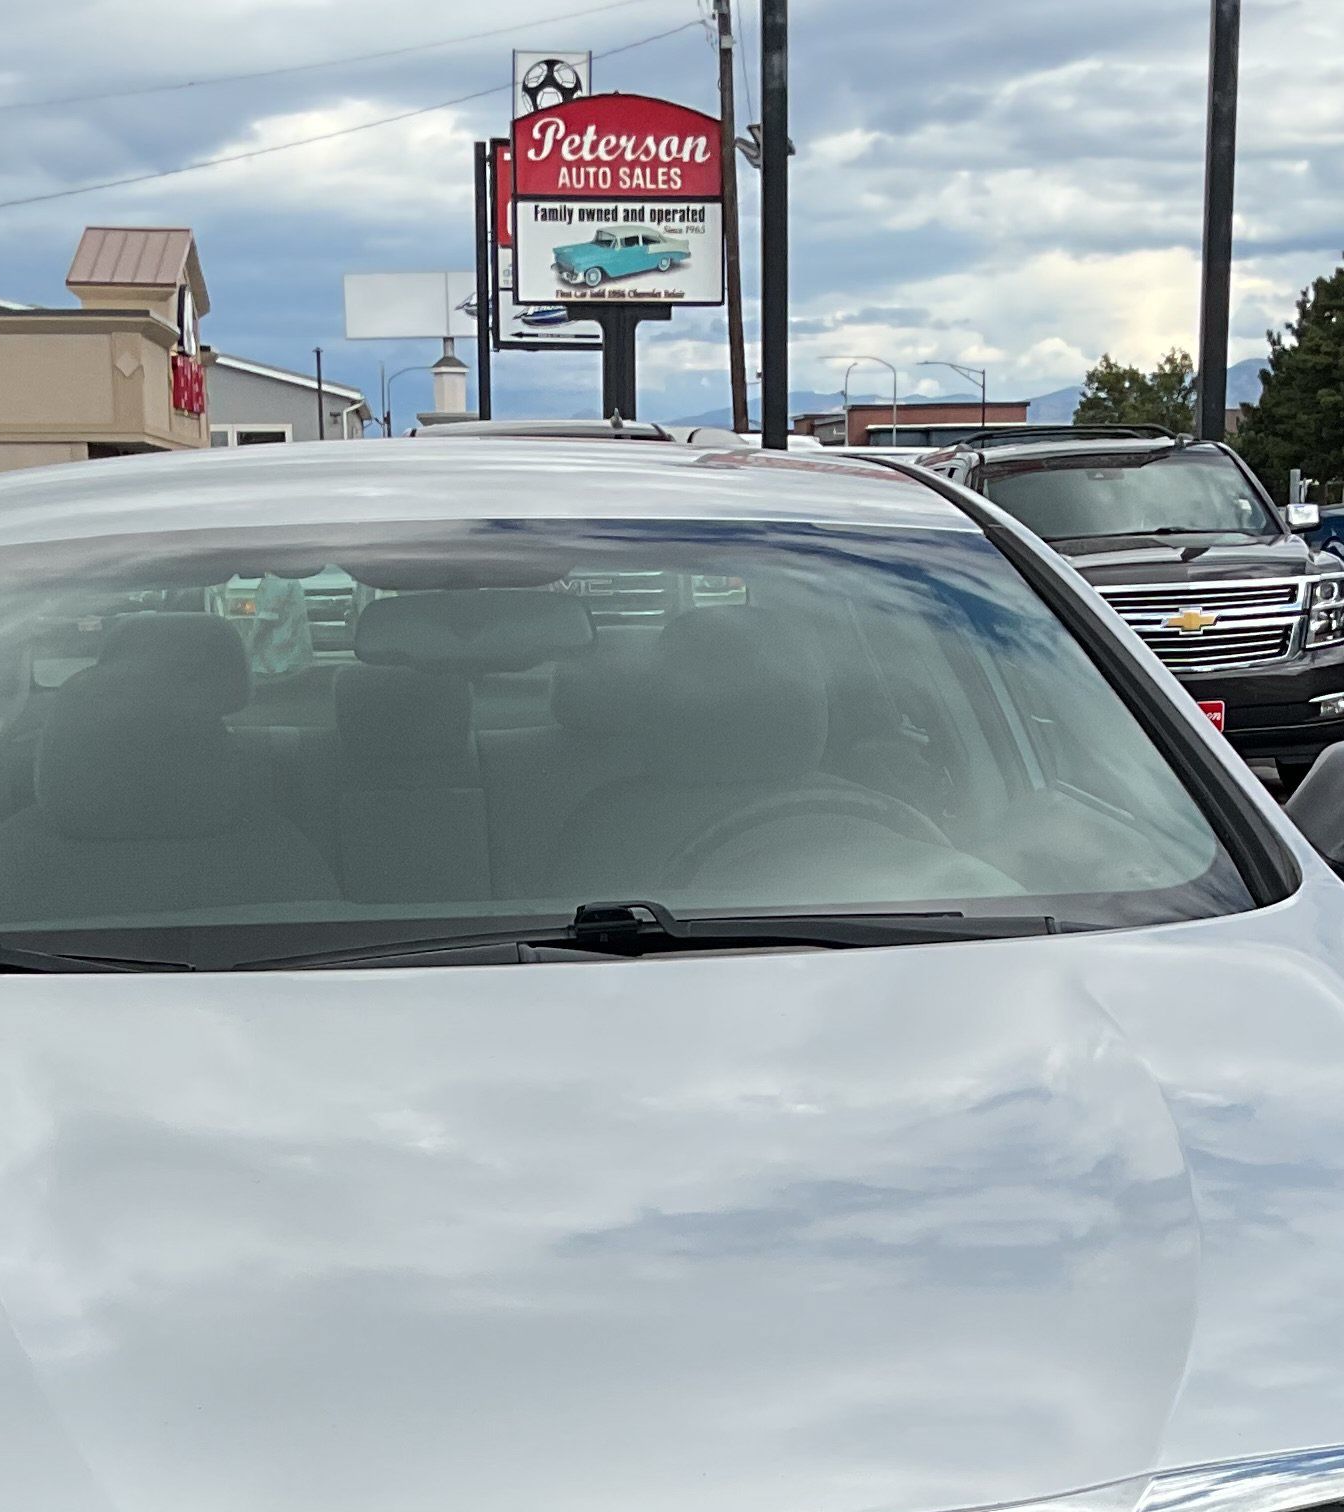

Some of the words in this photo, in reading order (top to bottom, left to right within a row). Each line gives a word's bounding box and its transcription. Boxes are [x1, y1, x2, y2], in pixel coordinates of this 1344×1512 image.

[527, 117, 711, 164] Peterson
[558, 167, 612, 189] AUTO
[619, 167, 682, 190] SALES
[534, 205, 573, 225] Family
[578, 206, 618, 222] owned
[623, 206, 645, 222] and
[650, 206, 705, 225] operated
